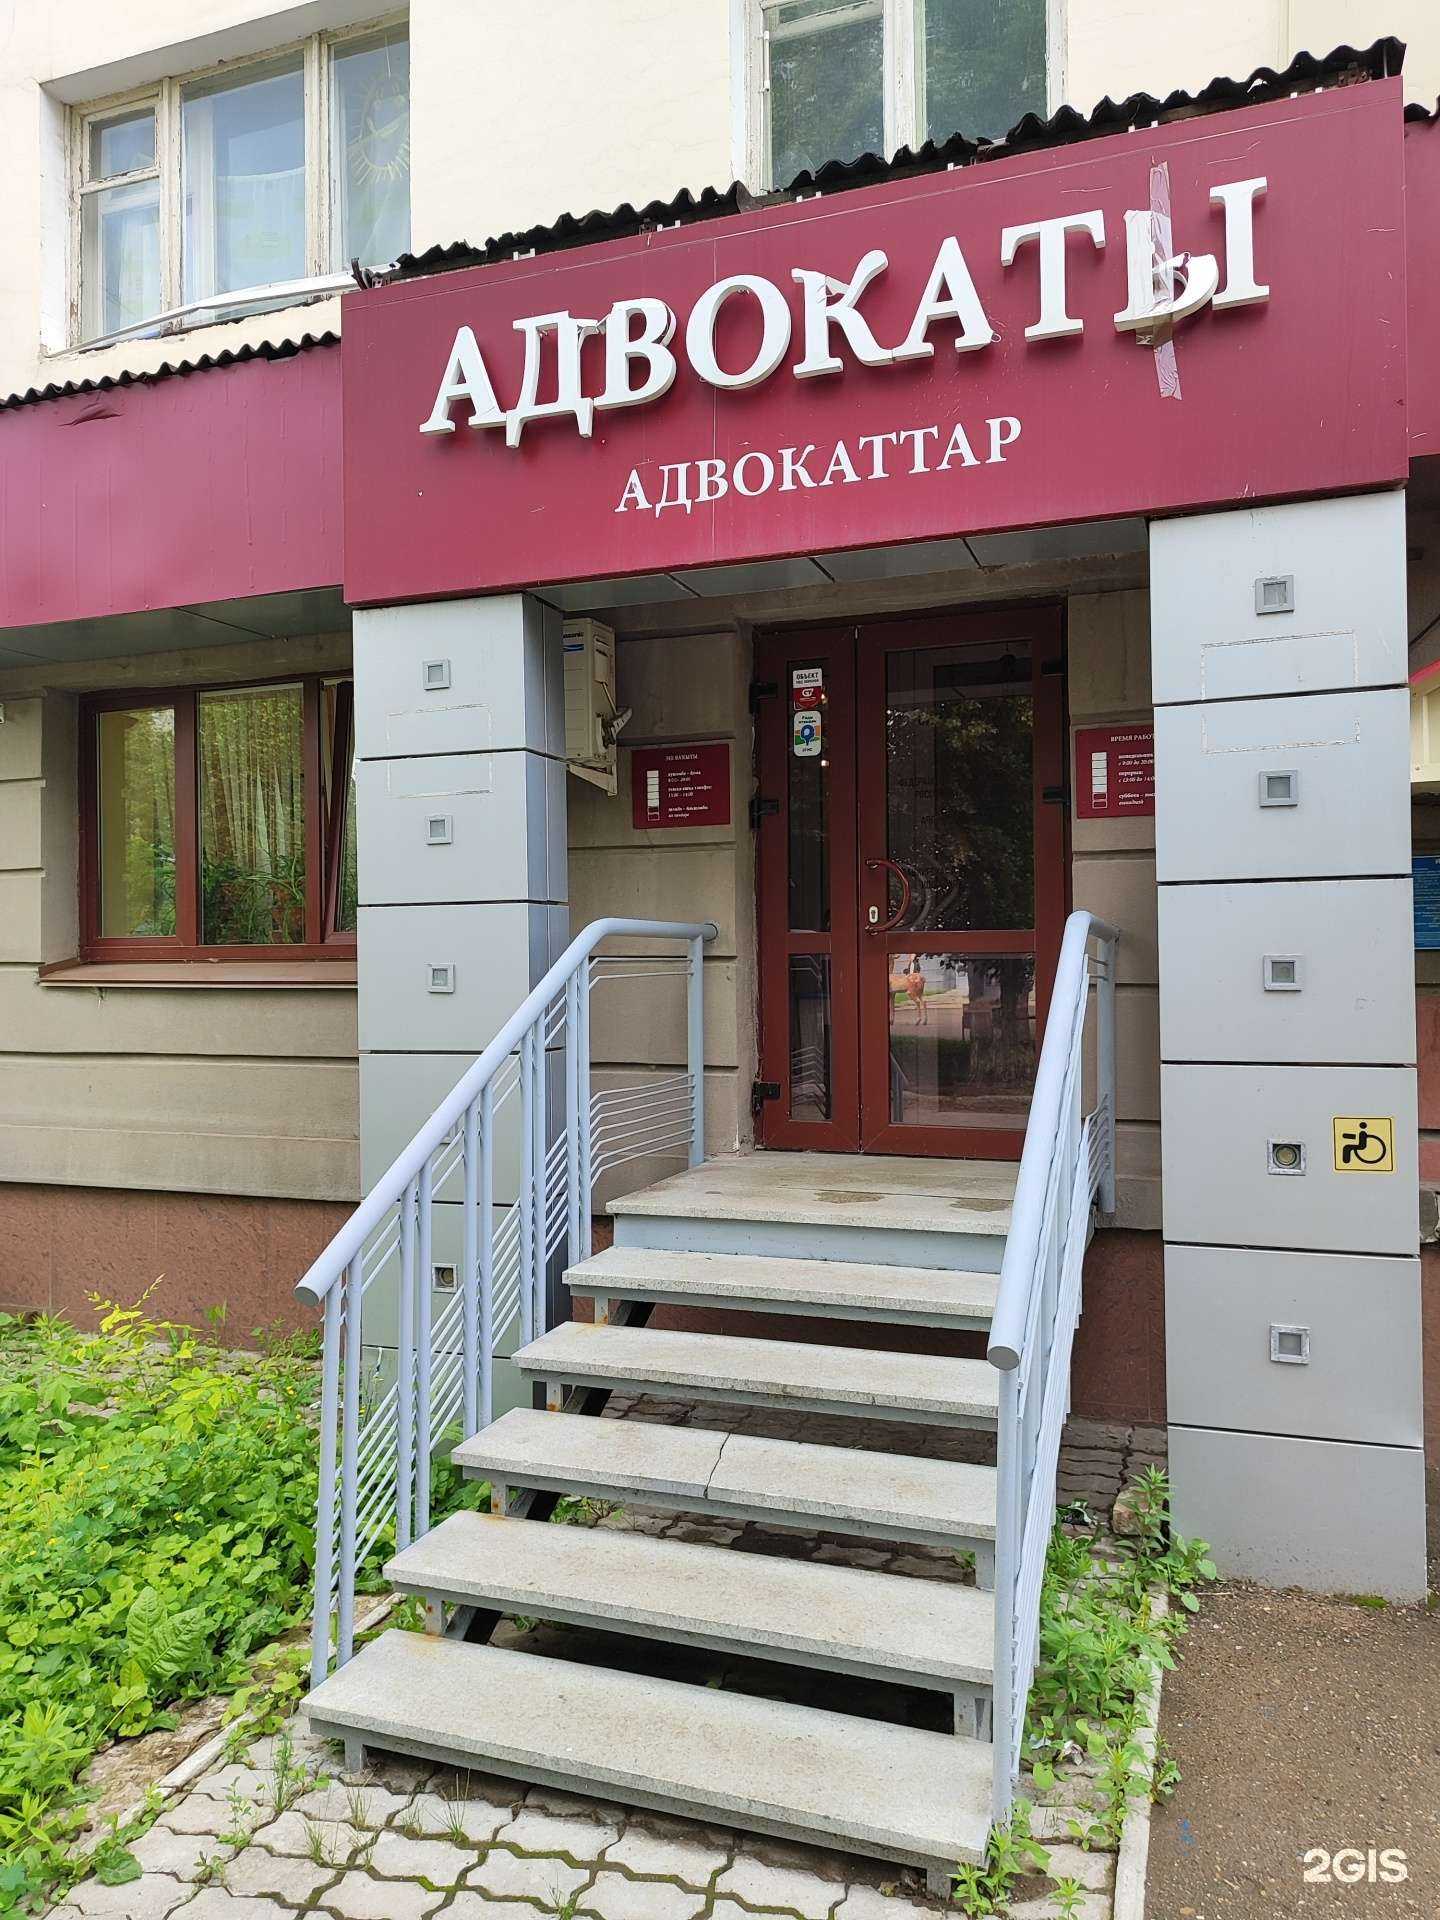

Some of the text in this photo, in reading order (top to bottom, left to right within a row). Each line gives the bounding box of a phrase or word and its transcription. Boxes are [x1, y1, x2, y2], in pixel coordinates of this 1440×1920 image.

[419, 177, 1270, 449] АДВОКАТЫ
[614, 415, 1022, 518] АДВОКАТТАР
[796, 672, 819, 680] ОБЪЕКТ
